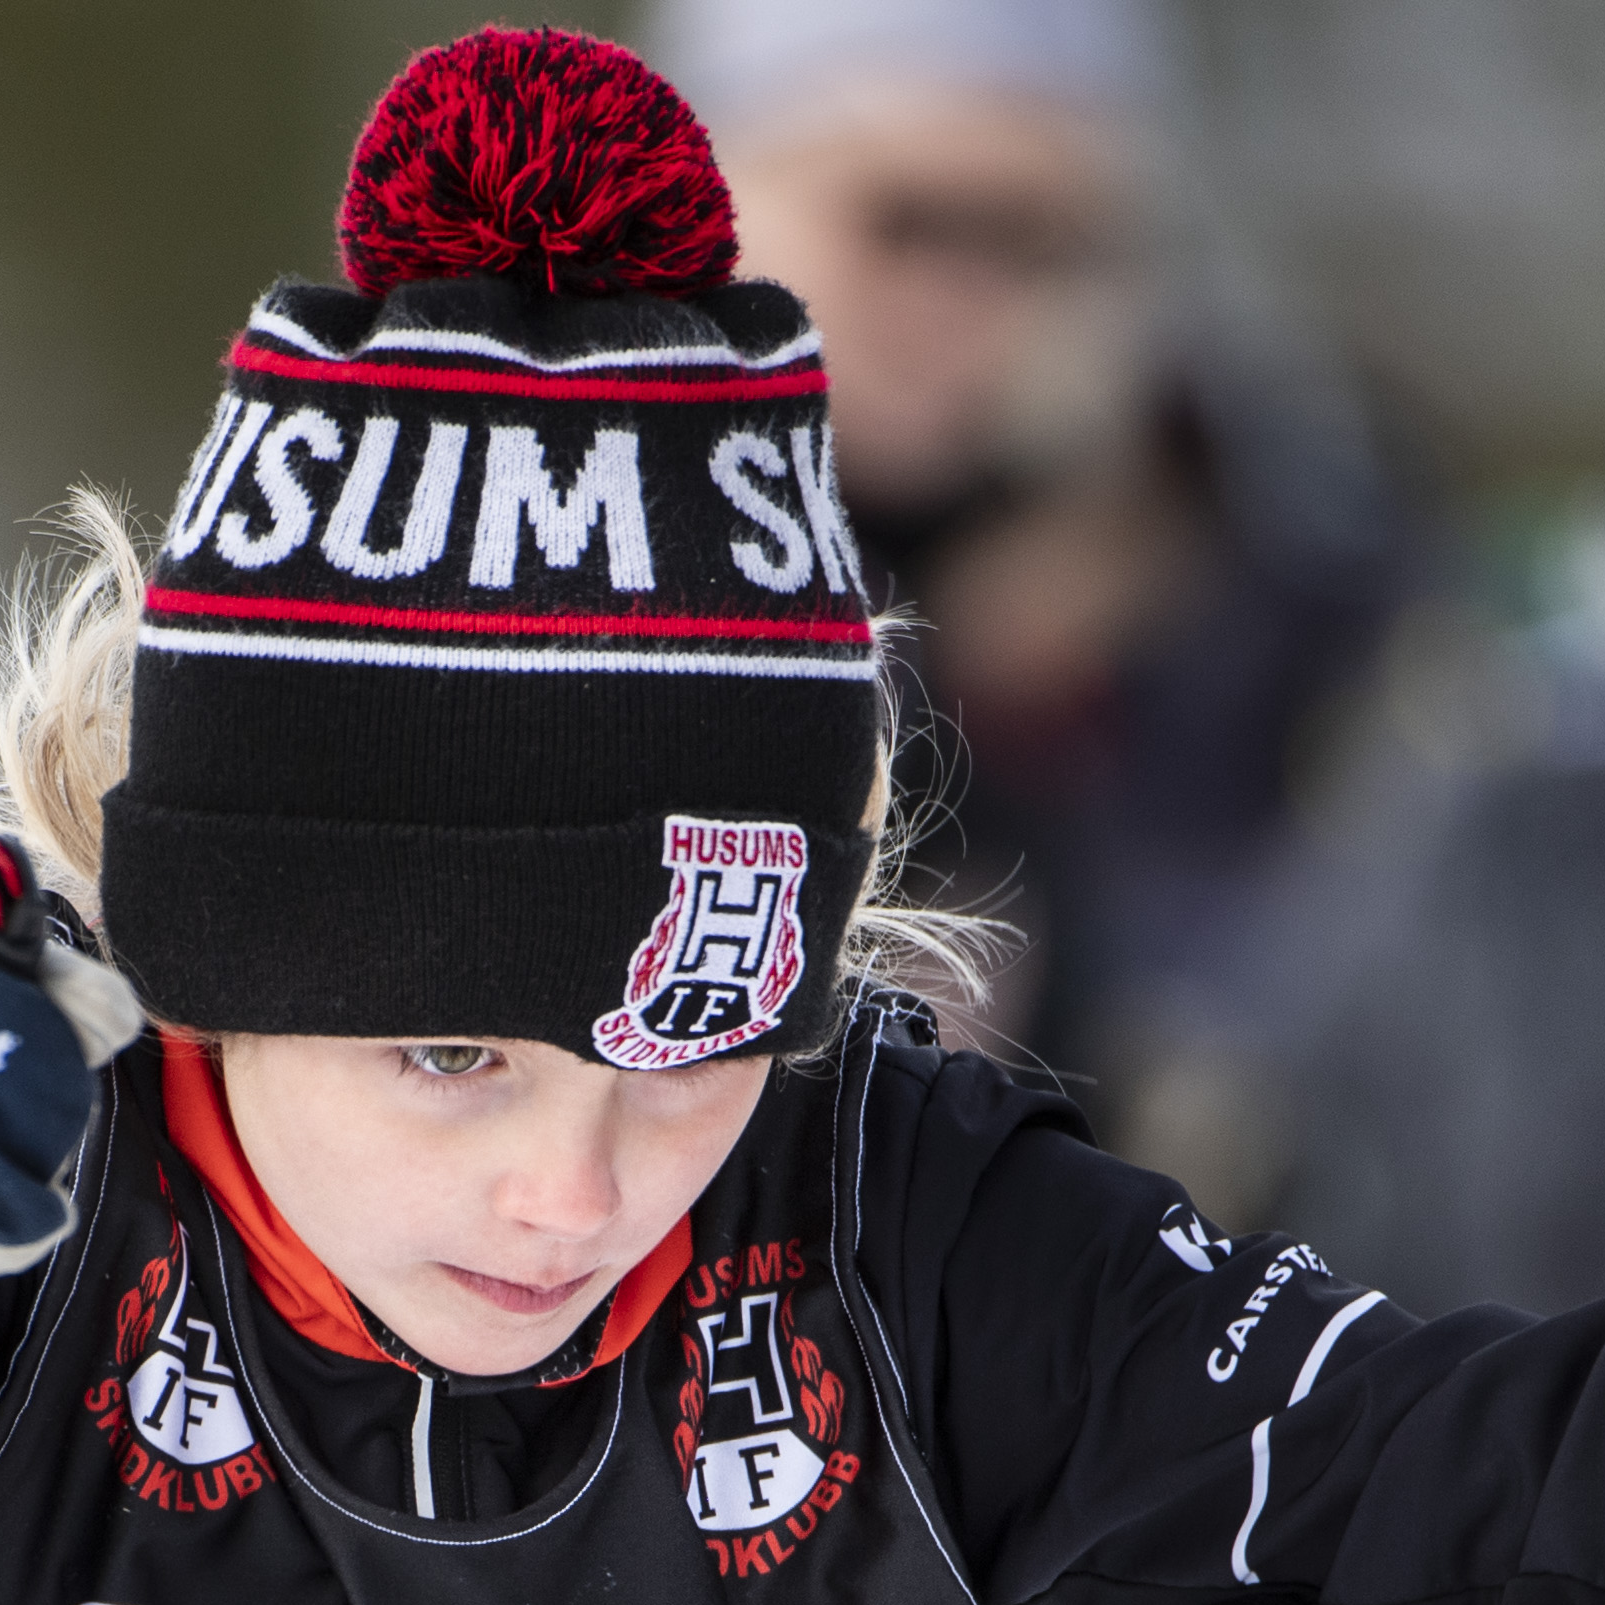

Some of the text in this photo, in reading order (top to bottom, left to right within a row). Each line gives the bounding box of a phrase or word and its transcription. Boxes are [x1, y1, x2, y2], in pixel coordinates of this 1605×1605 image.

[670, 825, 804, 868] HUSUMS
[673, 870, 782, 978] H
[599, 1012, 772, 1065] SKIDKLUBB
[685, 1238, 805, 1308] USUMS
